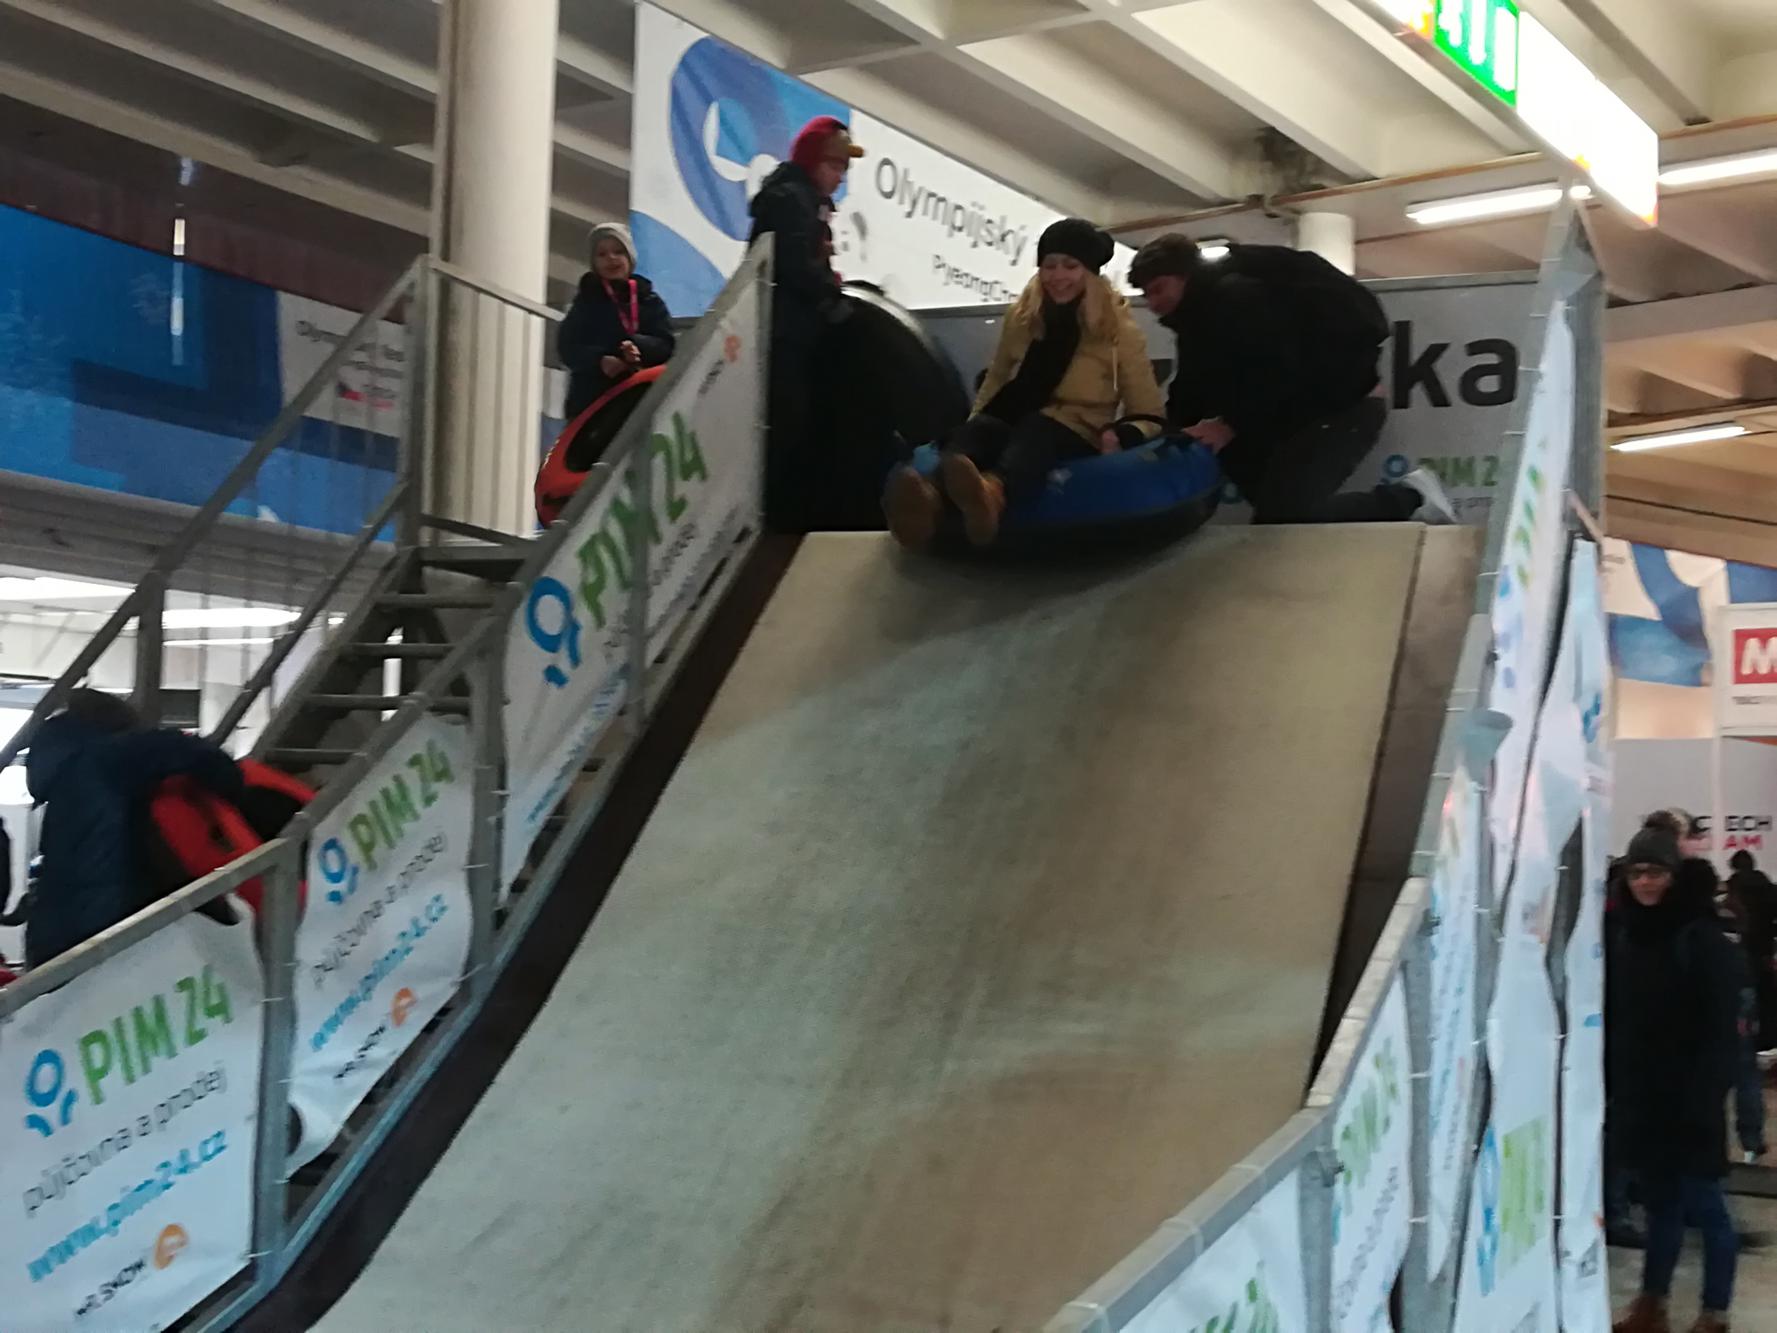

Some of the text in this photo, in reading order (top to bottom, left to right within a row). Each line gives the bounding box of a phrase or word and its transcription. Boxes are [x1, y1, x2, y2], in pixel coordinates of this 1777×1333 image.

[875, 157, 1028, 266] Olympijský
[1393, 320, 1520, 409] ka
[347, 739, 455, 871] PIM24
[77, 964, 234, 1105] PIM24
[136, 1114, 151, 1137] a
